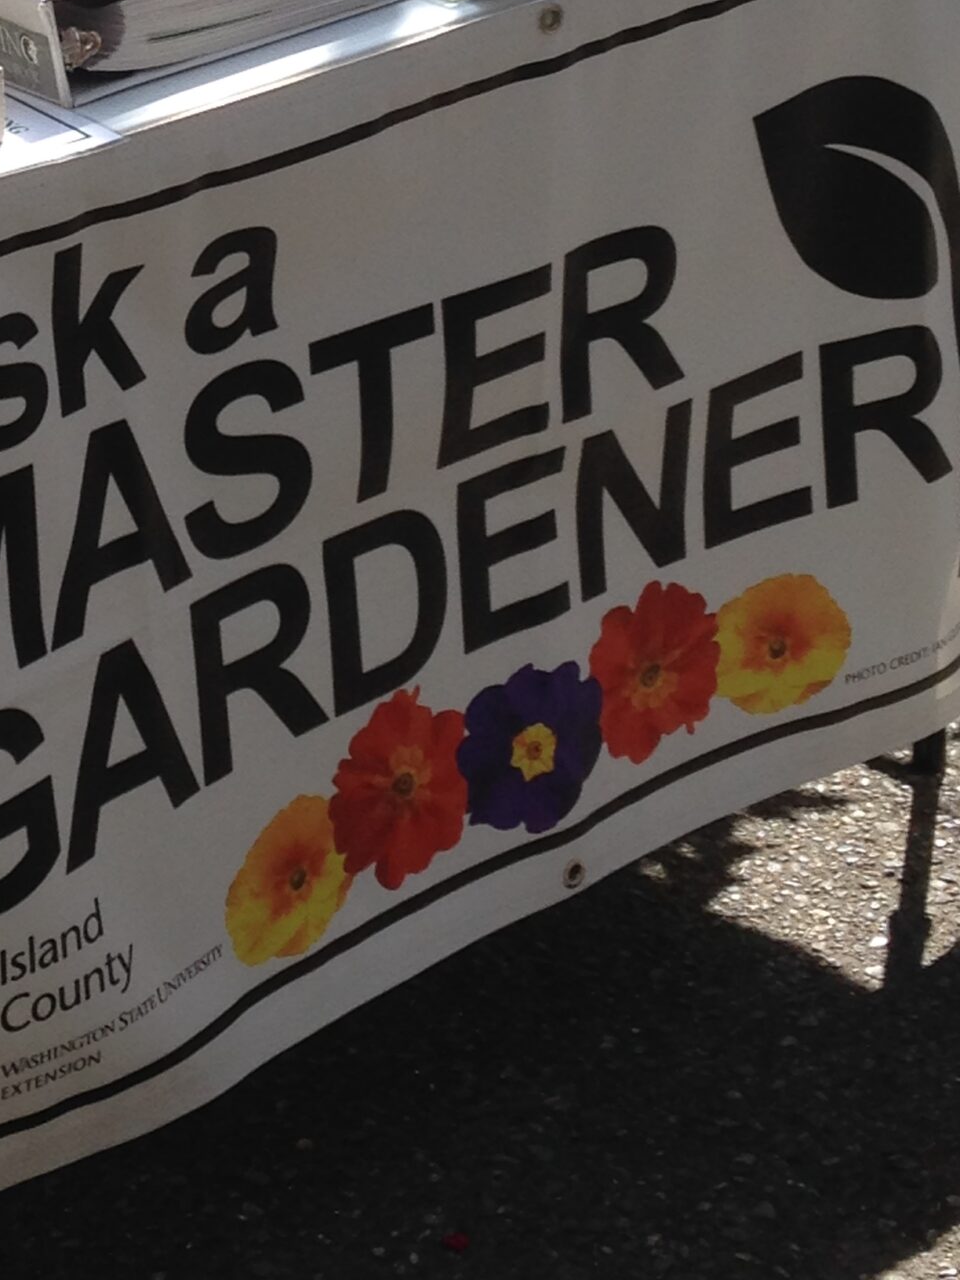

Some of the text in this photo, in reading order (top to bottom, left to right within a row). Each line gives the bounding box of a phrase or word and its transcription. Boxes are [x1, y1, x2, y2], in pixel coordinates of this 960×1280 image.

[184, 226, 279, 355] a
[844, 662, 887, 684] PHOTO
[0, 897, 105, 986] Island
[0, 943, 133, 1032] County
[0, 943, 223, 1078] WASHINGTON STATE UNIVERSITY
[0, 1051, 102, 1100] EXTENSION
